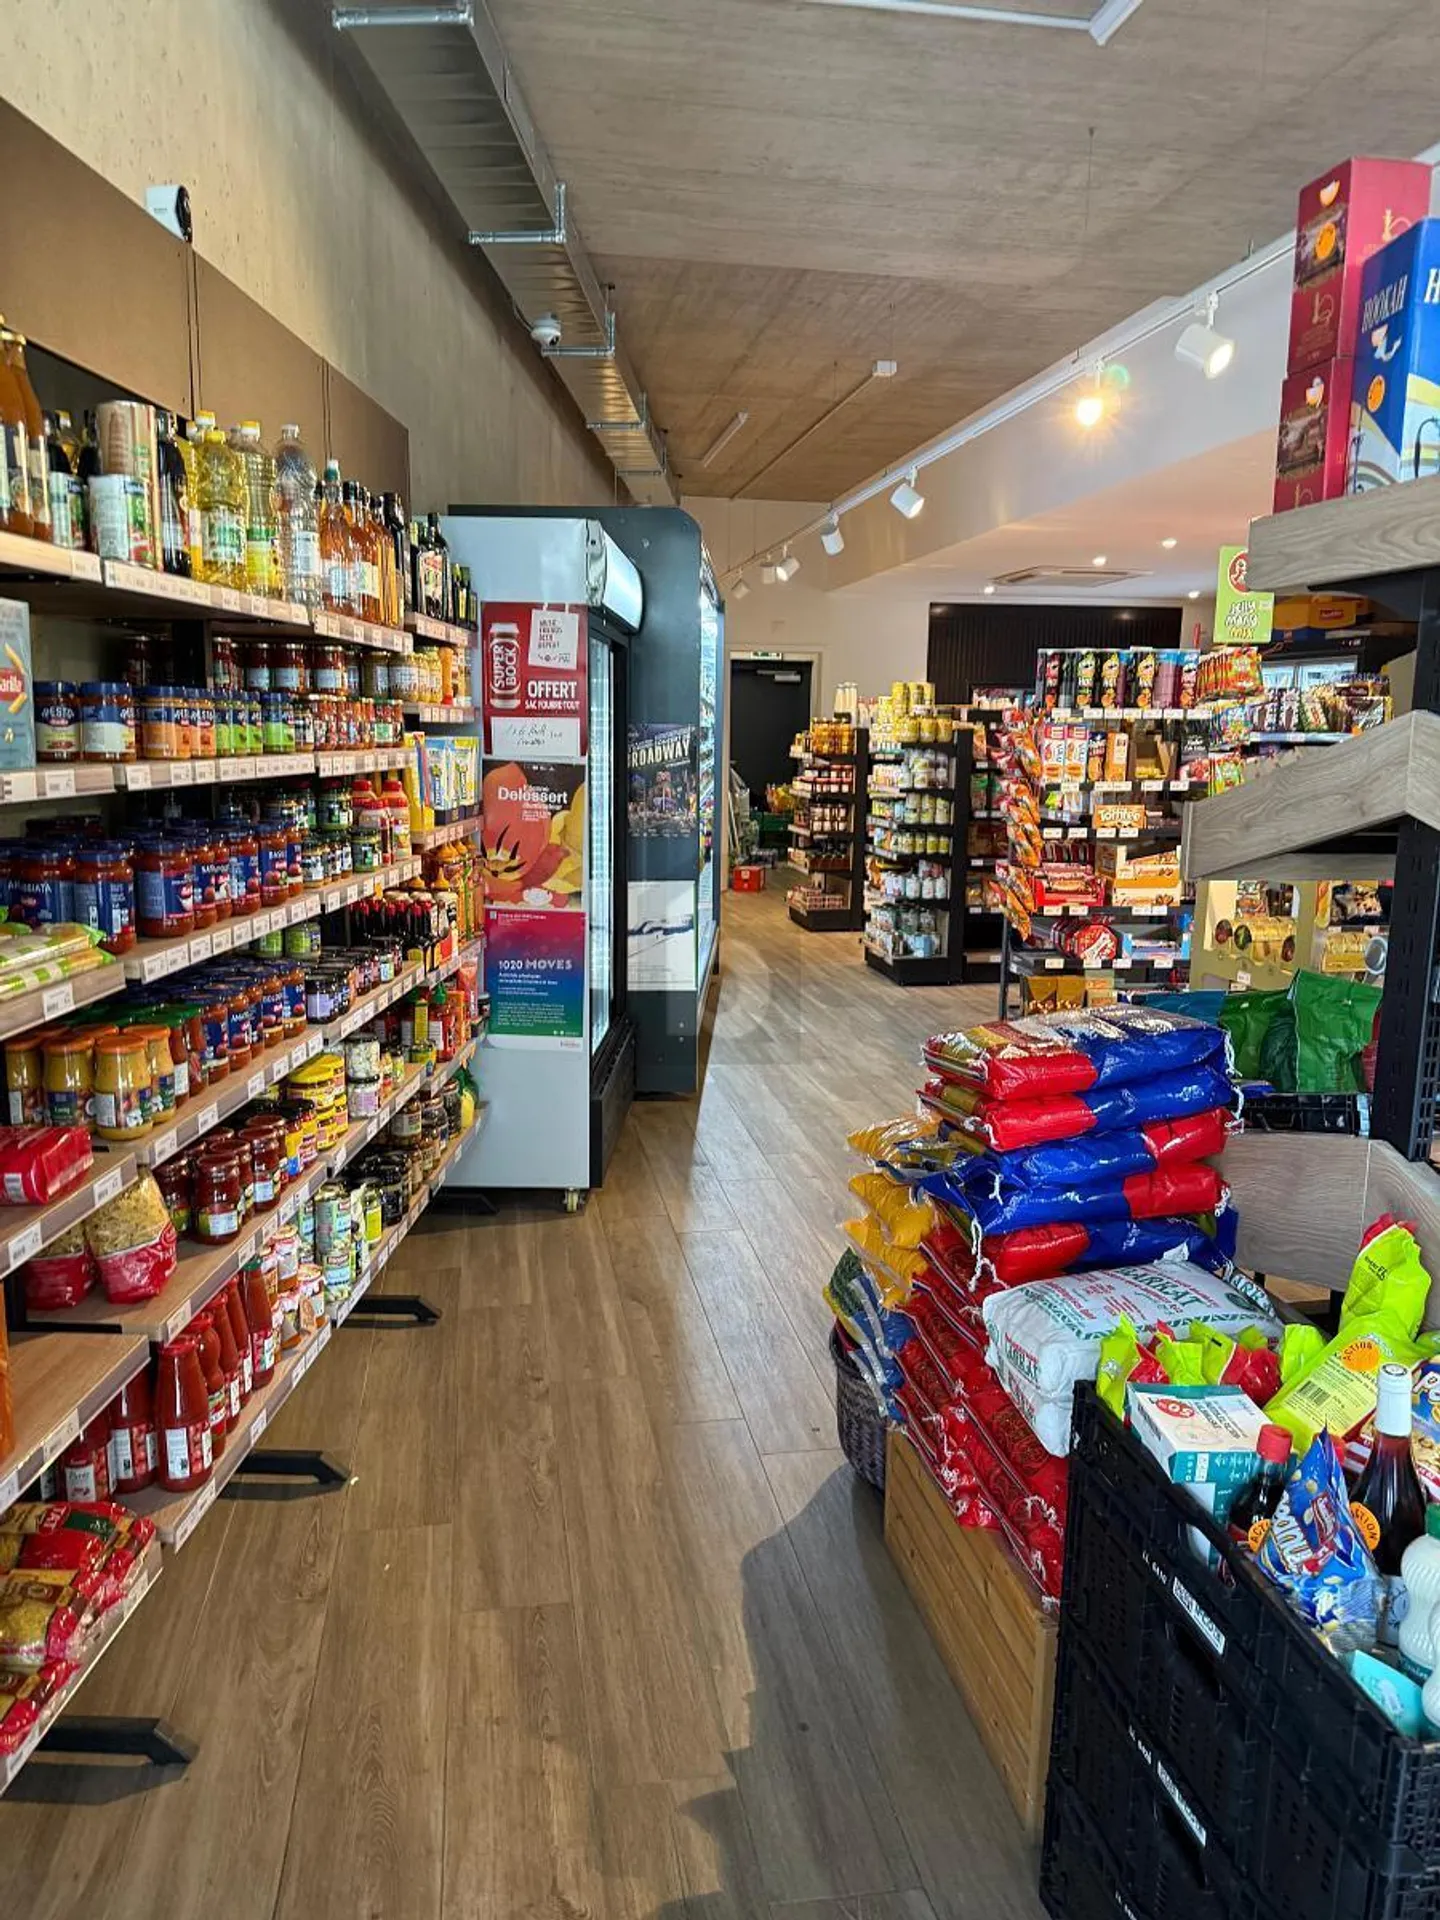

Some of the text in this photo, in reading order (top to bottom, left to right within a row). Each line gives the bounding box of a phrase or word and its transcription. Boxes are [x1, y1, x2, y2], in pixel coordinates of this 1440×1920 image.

[1362, 274, 1408, 333] HOOKAH
[493, 645, 505, 688] SUPER
[505, 647, 517, 686] BOCK
[528, 681, 577, 698] OFFERT
[525, 958, 572, 970] MOVES
